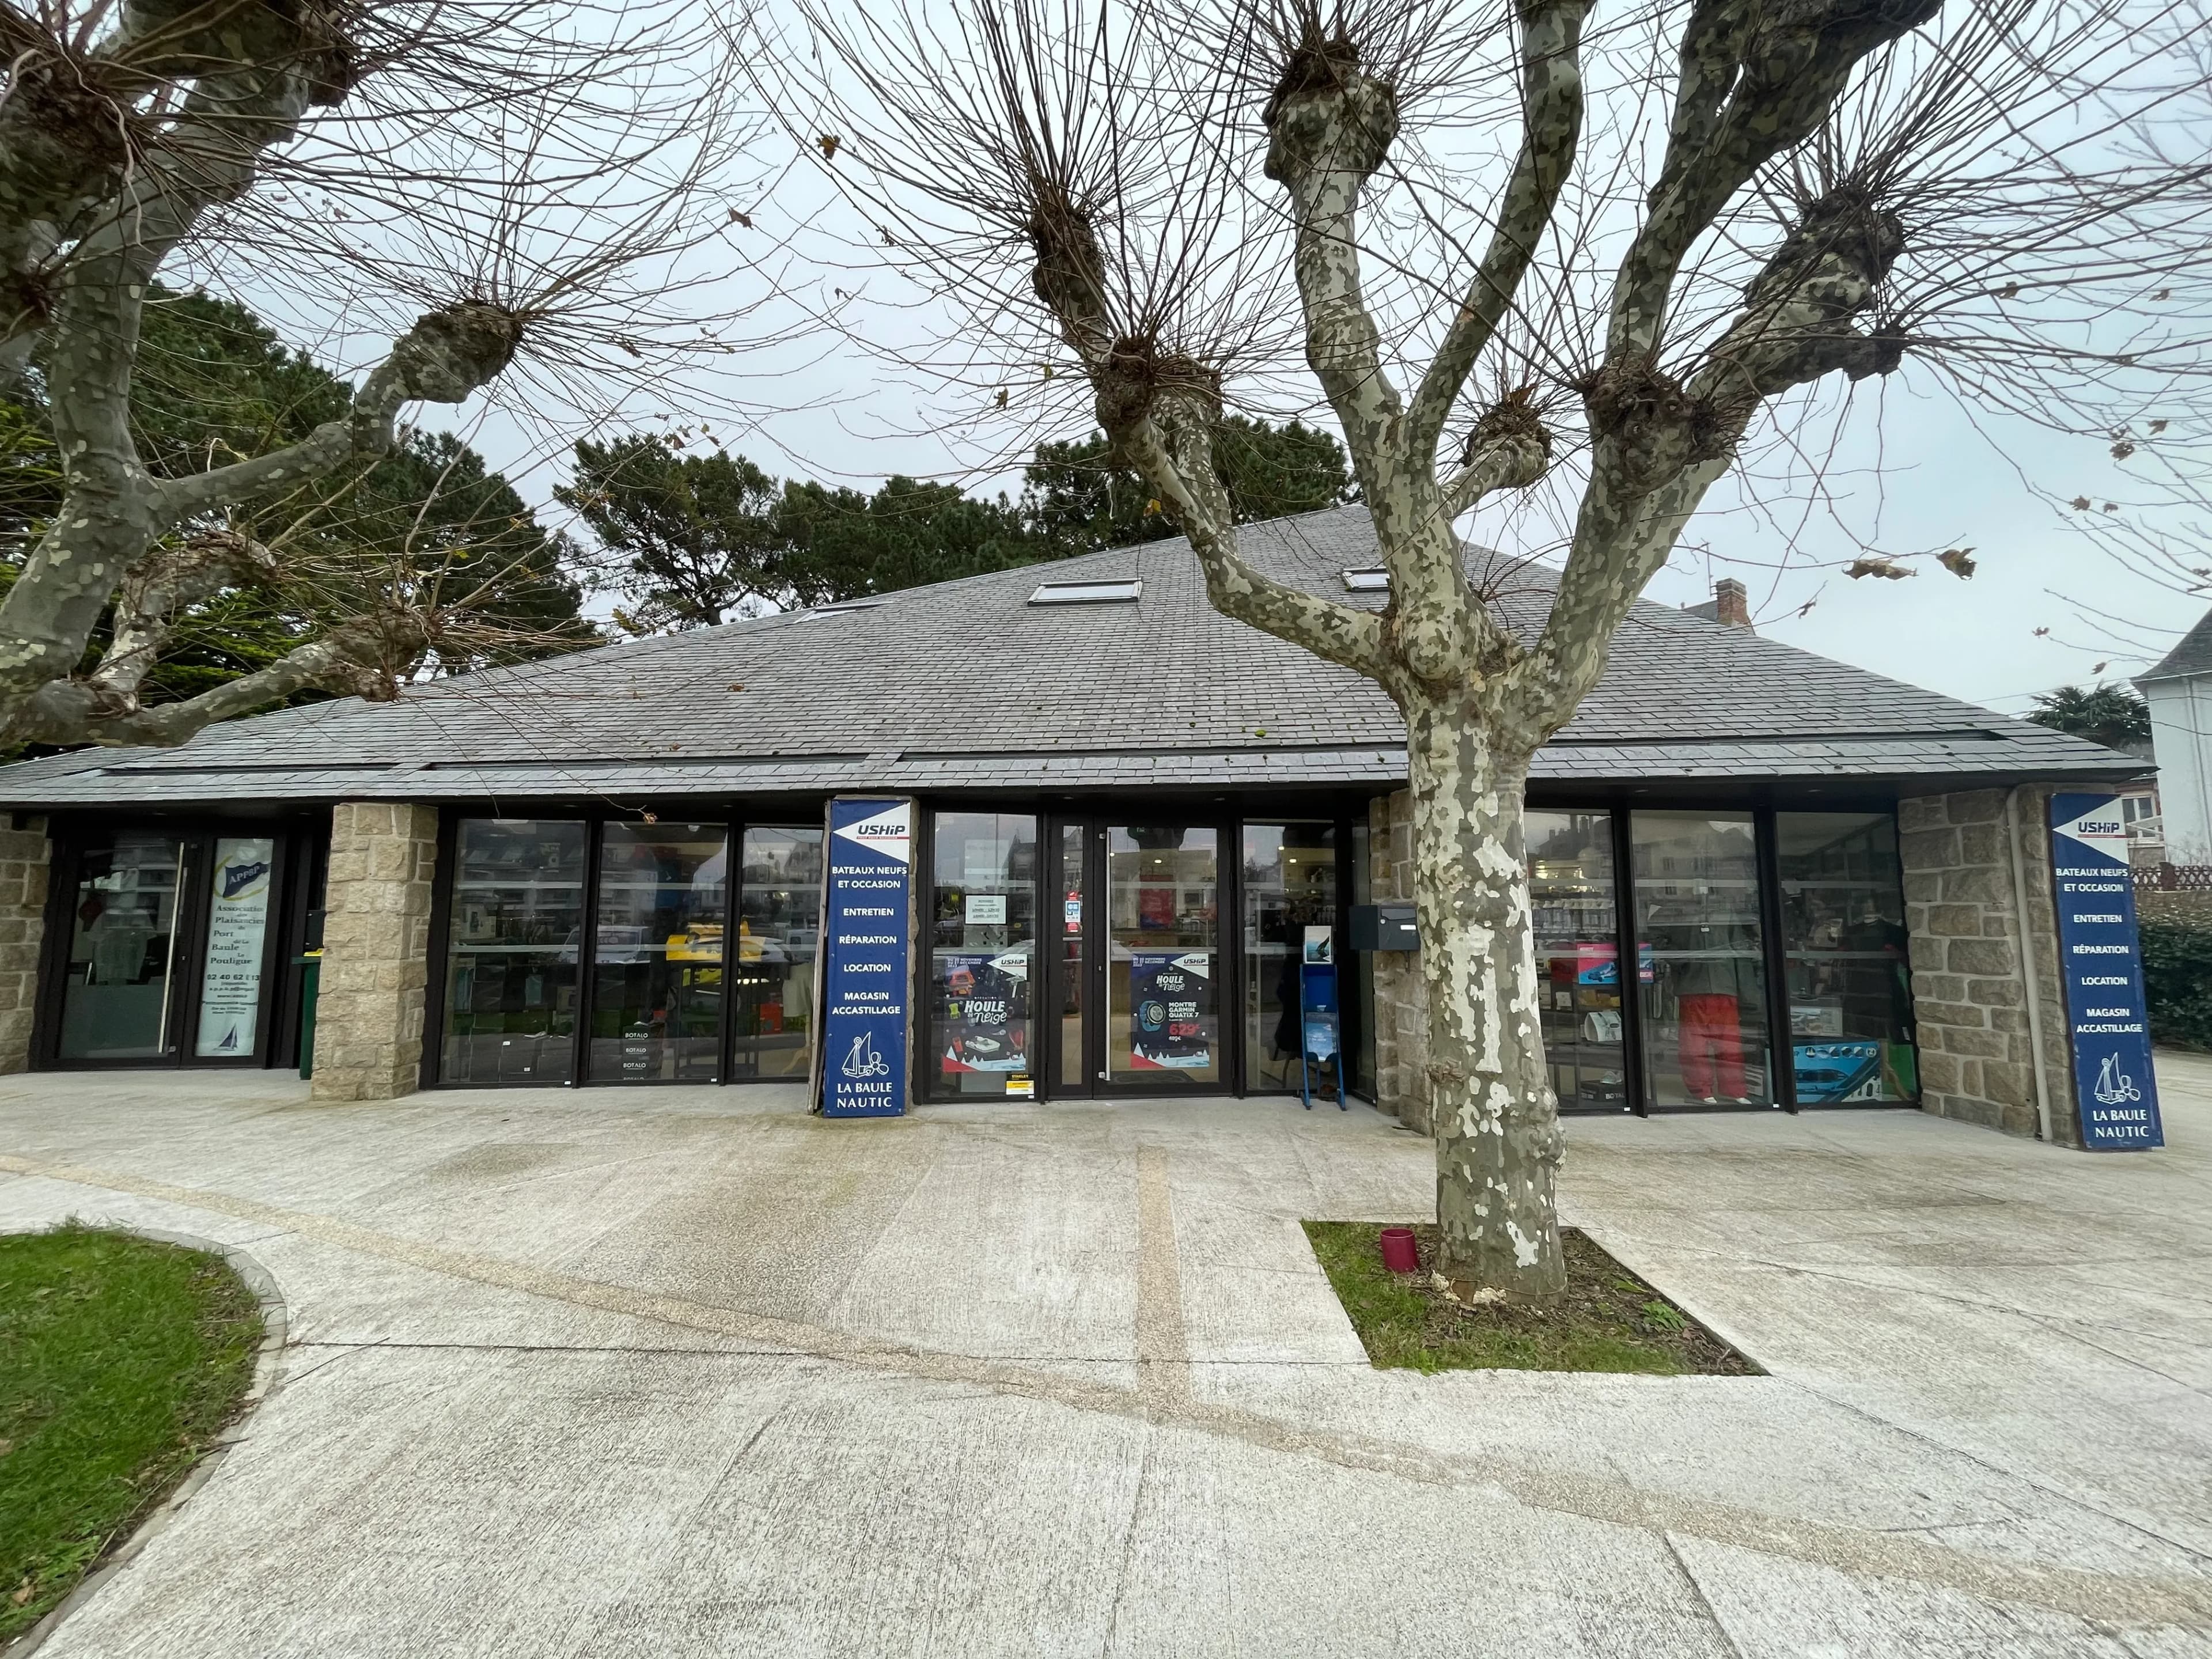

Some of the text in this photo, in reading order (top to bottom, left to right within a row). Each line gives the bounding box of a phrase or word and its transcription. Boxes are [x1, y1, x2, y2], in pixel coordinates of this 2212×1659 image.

[832, 866, 907, 874] BATEAUX NEUFS
[2055, 868, 2128, 877] BATEAUX NEUFS
[851, 880, 901, 889] OCCASION
[2064, 883, 2124, 892] ET OCCASION
[843, 908, 894, 916] ENTRETIEN
[2073, 914, 2123, 923] ENTRETIEN
[839, 934, 897, 944] RÉPARATION
[2073, 944, 2129, 954] RÉPARATION
[843, 964, 891, 972] LOCATION
[1156, 975, 1184, 984] HOULE
[2081, 977, 2128, 986] LOCATION
[844, 993, 889, 1001] MAGASIN
[832, 1006, 901, 1015] ACCASTILLAGE
[964, 1001, 1005, 1013] HOULE
[2086, 1009, 2130, 1017] MAGASIN
[974, 1012, 1007, 1025] neige
[2077, 1024, 2143, 1033] ACCASTILLAGE
[838, 1082, 893, 1093] LA BAULE
[837, 1097, 892, 1108] NAUTIC
[2093, 1109, 2147, 1121] LA BAULE
[2094, 1126, 2150, 1138] NAUTIC
